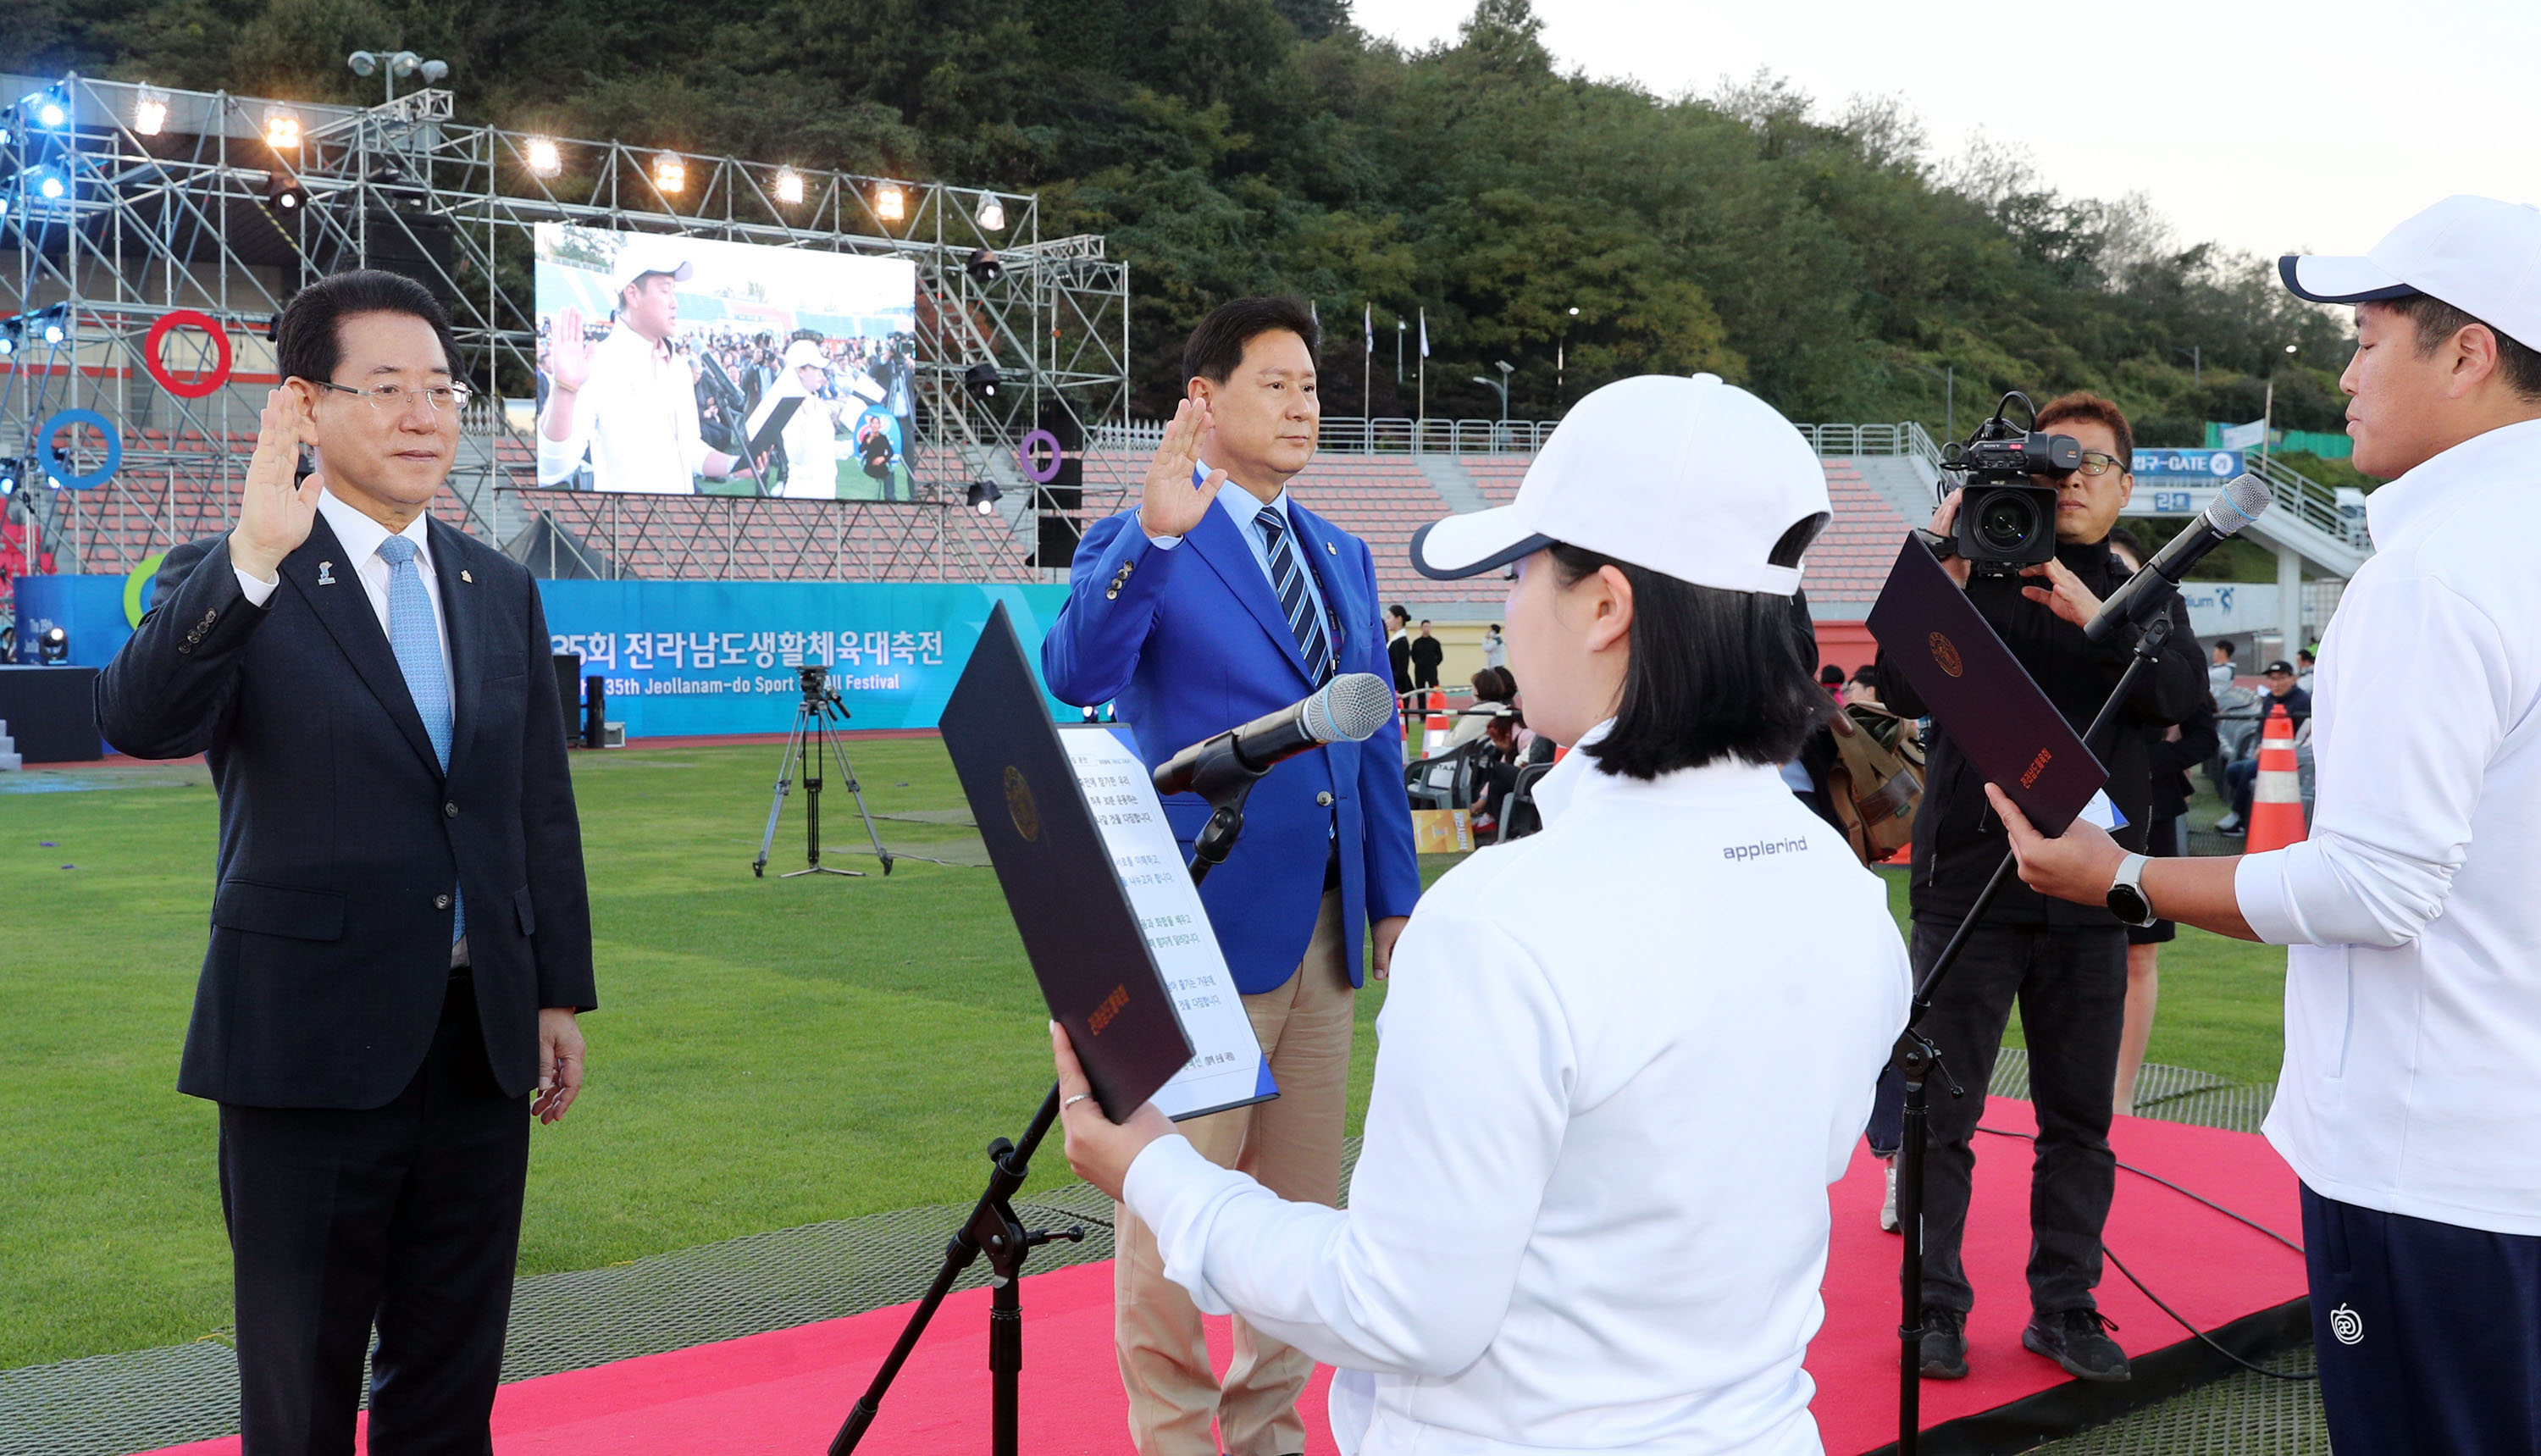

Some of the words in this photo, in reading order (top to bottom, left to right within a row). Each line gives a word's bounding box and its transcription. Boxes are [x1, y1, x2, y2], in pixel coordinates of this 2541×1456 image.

[551, 632, 617, 670] 35회
[624, 630, 943, 670] 전라남도생활체육대축전
[606, 678, 640, 695] 35th
[645, 677, 751, 696] Jeollanam-do
[756, 675, 794, 695] Sport
[824, 674, 842, 690] All
[846, 673, 900, 690] Festival
[1723, 835, 1808, 861] applerind
